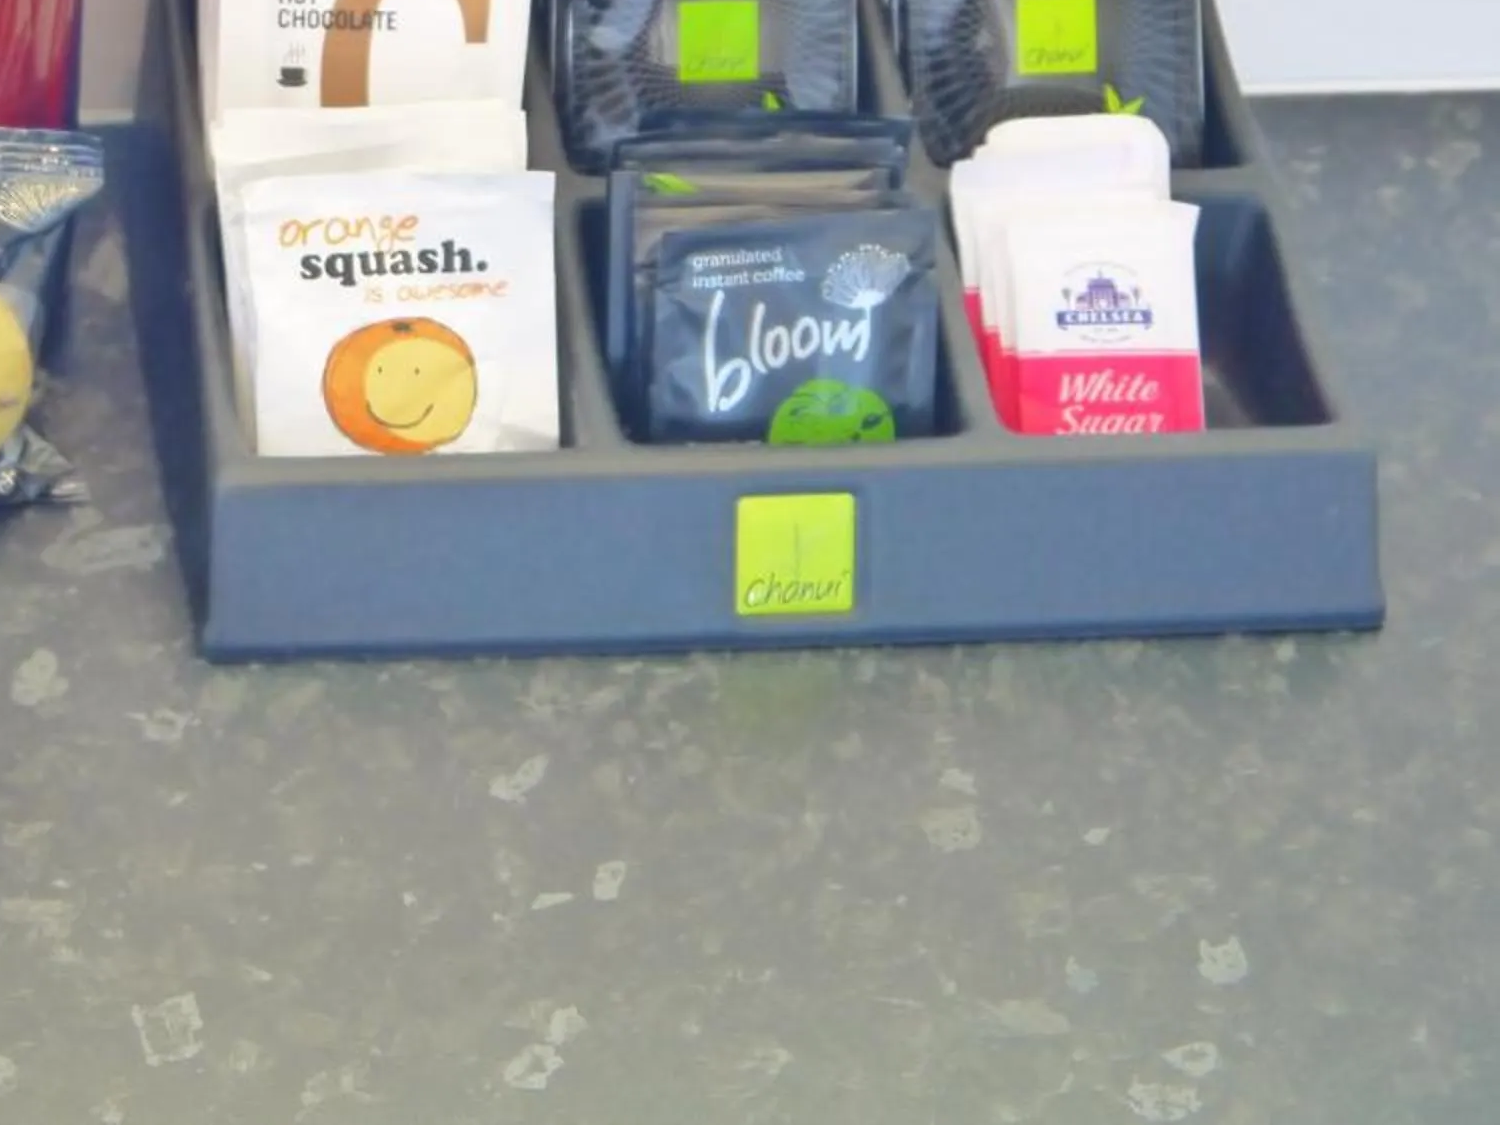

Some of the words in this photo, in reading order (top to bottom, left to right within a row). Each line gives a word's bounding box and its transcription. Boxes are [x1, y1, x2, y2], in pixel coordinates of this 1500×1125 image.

[277, 9, 397, 31] CHOCOLATE
[279, 213, 419, 255] orange
[300, 240, 488, 286] squash.
[692, 247, 783, 271] granulated
[397, 280, 509, 303] awesome
[693, 271, 749, 288] instant
[753, 266, 805, 284] coffee
[704, 290, 872, 412] bloom
[1058, 369, 1160, 403] White
